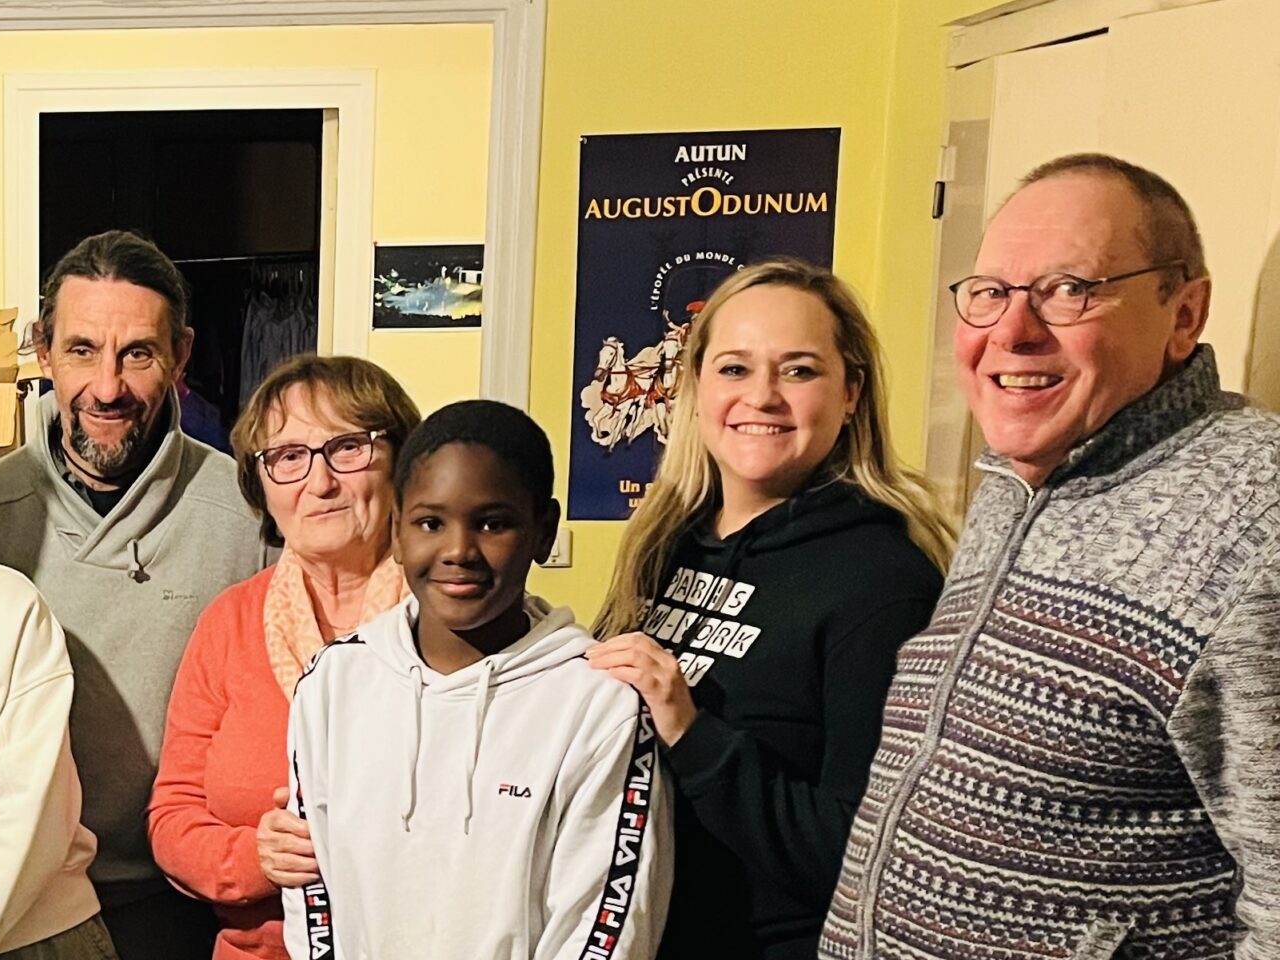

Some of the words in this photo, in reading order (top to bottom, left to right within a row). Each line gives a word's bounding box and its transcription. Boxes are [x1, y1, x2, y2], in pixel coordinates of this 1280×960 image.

[674, 144, 747, 163] AUTUN
[584, 186, 828, 220] AUGUSTODUNUM
[675, 254, 691, 265] DU
[696, 251, 735, 265] MONDE
[619, 480, 641, 493] Un
[498, 784, 532, 798] FILA
[615, 812, 646, 867] FILA
[599, 874, 632, 929] FILA
[309, 912, 331, 960] FILA
